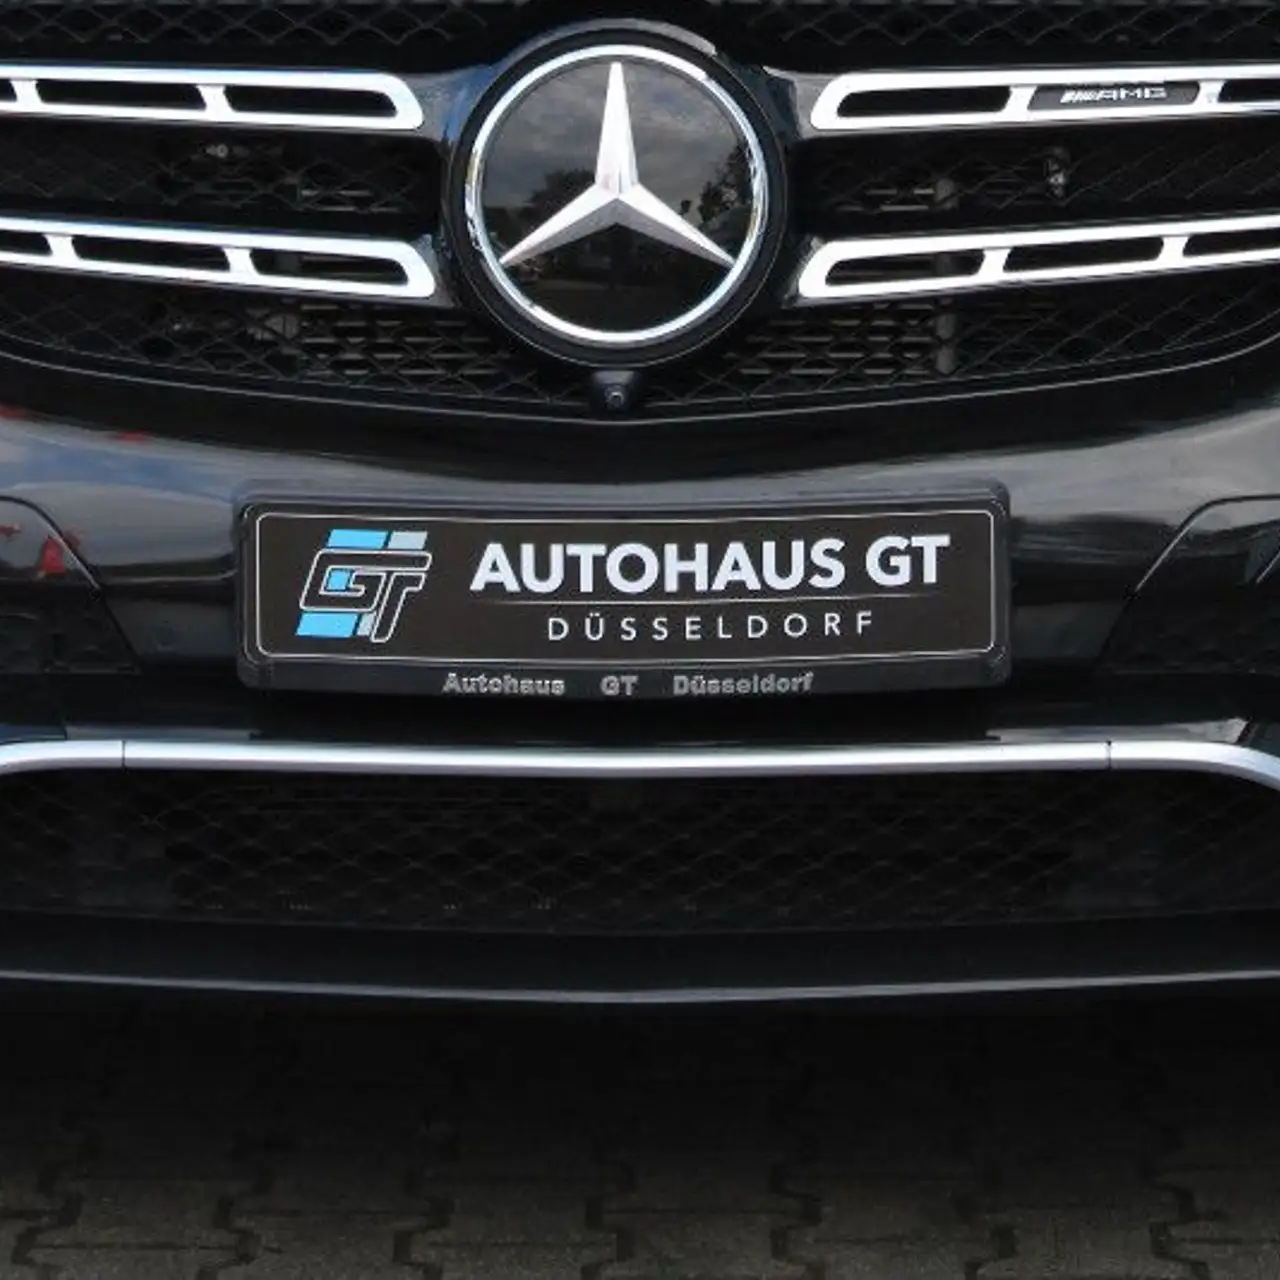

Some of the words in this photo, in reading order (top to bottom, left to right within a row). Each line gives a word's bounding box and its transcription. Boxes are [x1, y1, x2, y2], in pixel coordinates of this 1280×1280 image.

[469, 538, 846, 594] AUTOHAUS
[864, 533, 951, 588] GT
[547, 608, 874, 642] DÜSSELDORF
[441, 672, 566, 696] Autohaus
[600, 674, 639, 696] GT
[672, 670, 814, 696] Düsseldorf
